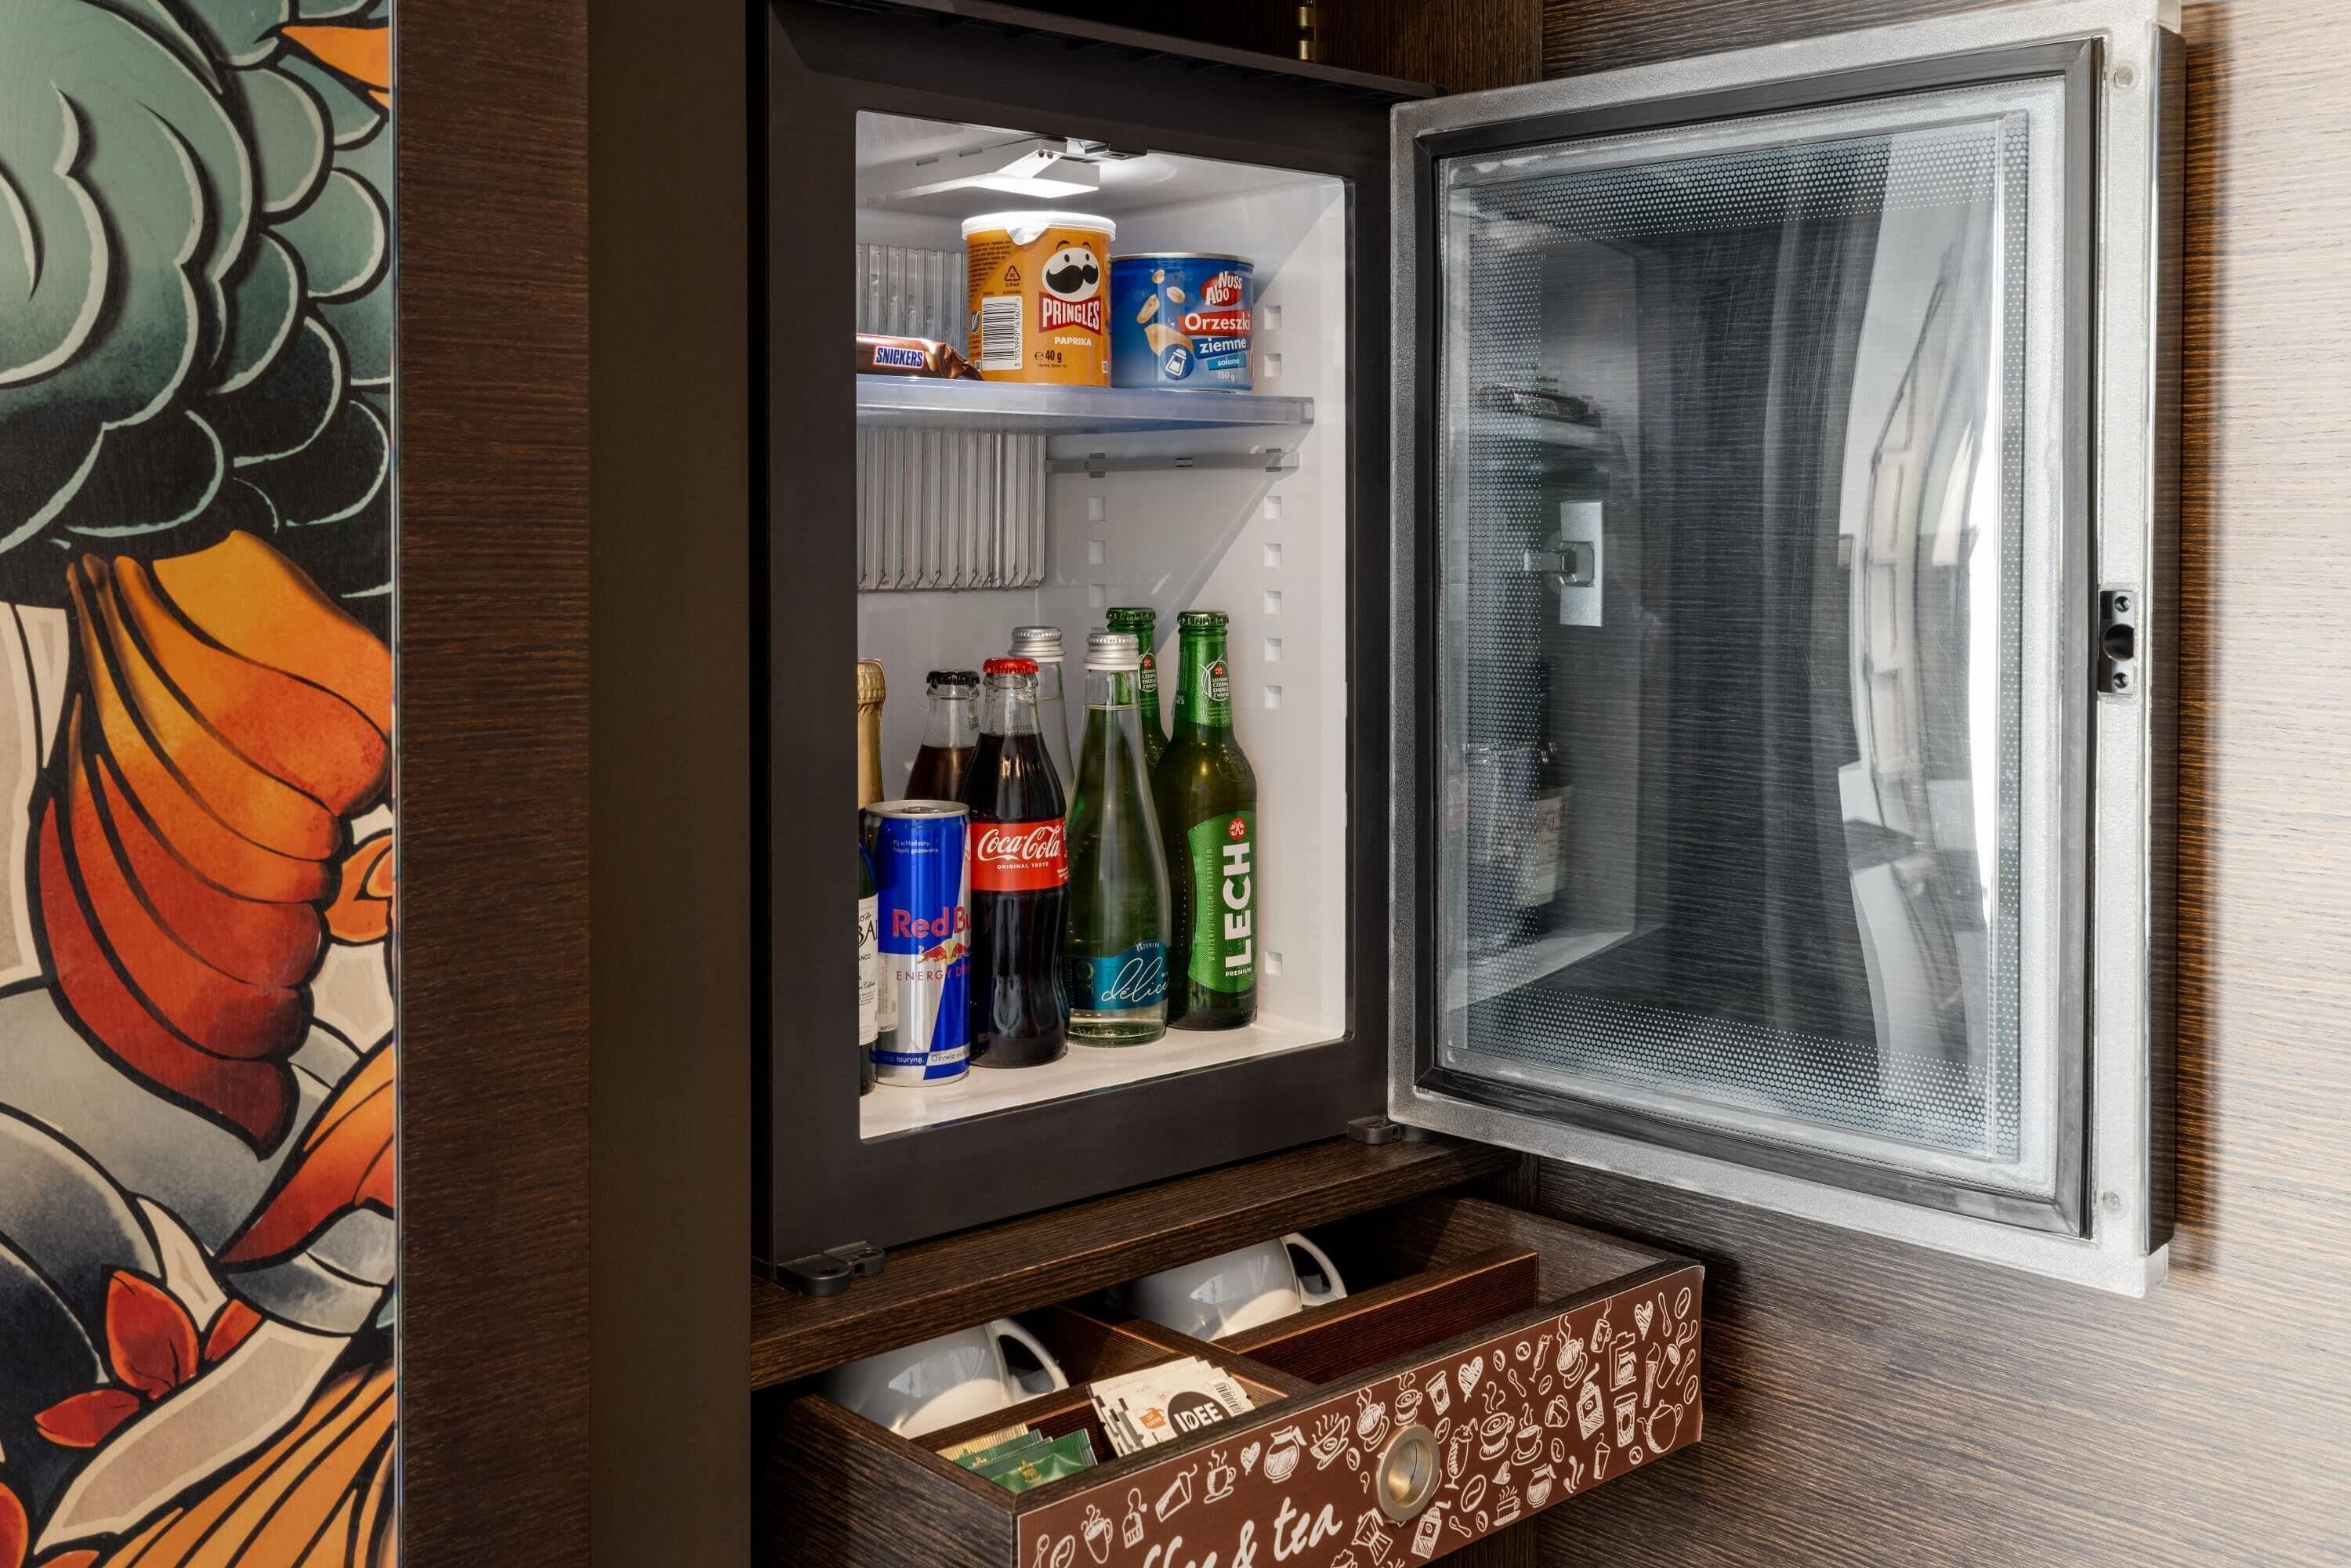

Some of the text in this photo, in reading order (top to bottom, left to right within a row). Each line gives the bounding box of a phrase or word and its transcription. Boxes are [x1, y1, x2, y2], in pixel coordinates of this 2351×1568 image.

[1218, 271, 1243, 290] Nuss
[1205, 284, 1230, 306] Abo
[1042, 298, 1099, 331] PRINGLES
[1184, 312, 1251, 331] Orzeszki
[1054, 336, 1092, 346] PAPRIKA
[1200, 338, 1247, 354] ziemne
[875, 347, 923, 368] SNICKERS
[1045, 349, 1055, 360] 40
[1056, 352, 1062, 363] g
[977, 824, 1062, 862] Coca-Cola
[1223, 842, 1252, 969] LECH
[891, 906, 971, 939] Red Bu
[896, 964, 970, 981] ENERGY DR
[1225, 967, 1252, 977] PREMIUM
[1174, 1402, 1224, 1432] IDEE
[1273, 1496, 1343, 1562] tea
